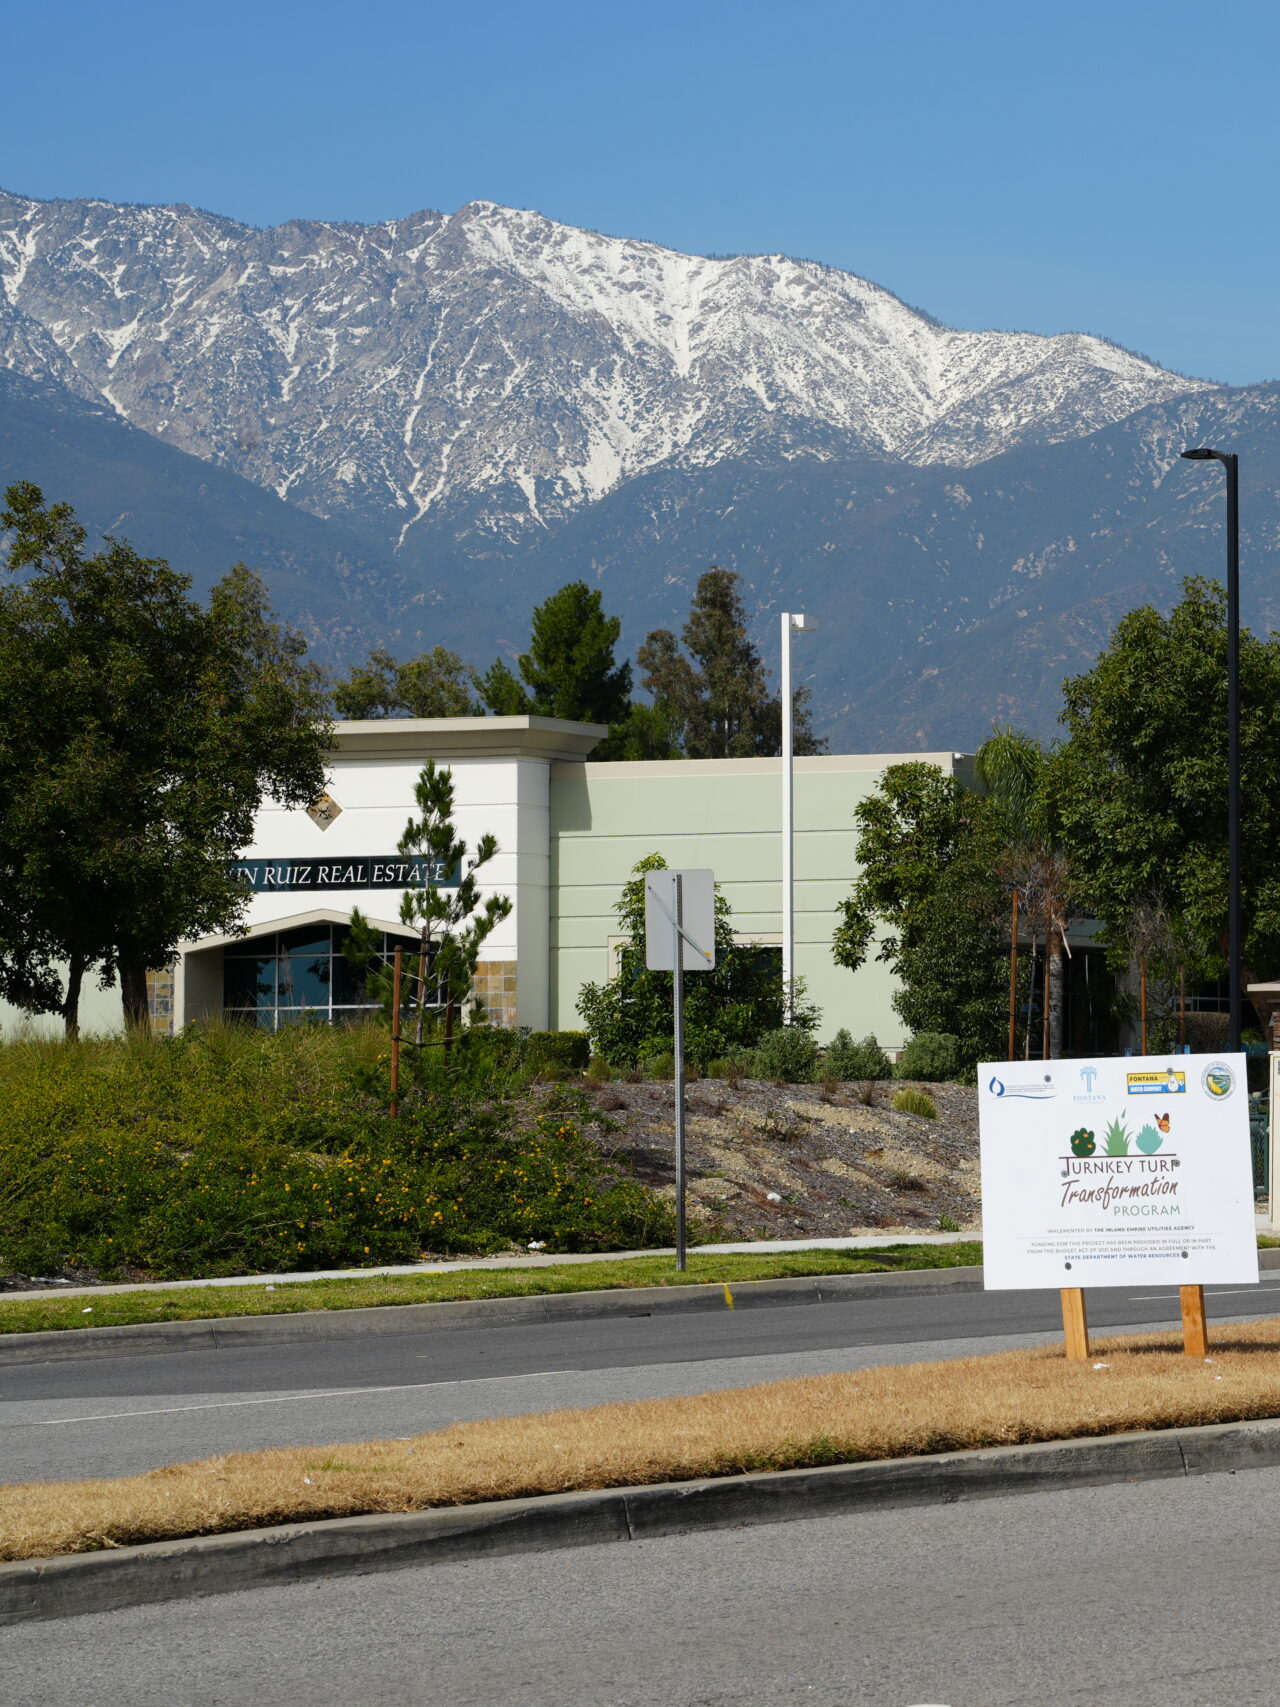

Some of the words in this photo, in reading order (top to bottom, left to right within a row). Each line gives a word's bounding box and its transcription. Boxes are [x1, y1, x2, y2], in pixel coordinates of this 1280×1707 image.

[262, 866, 312, 885] RUIZ
[316, 864, 368, 884] REAL
[372, 863, 447, 883] ESTATE
[1064, 1157, 1133, 1176] TURNKEY
[1061, 1175, 1178, 1210] Transformation
[1113, 1205, 1181, 1217] PROGRAM
